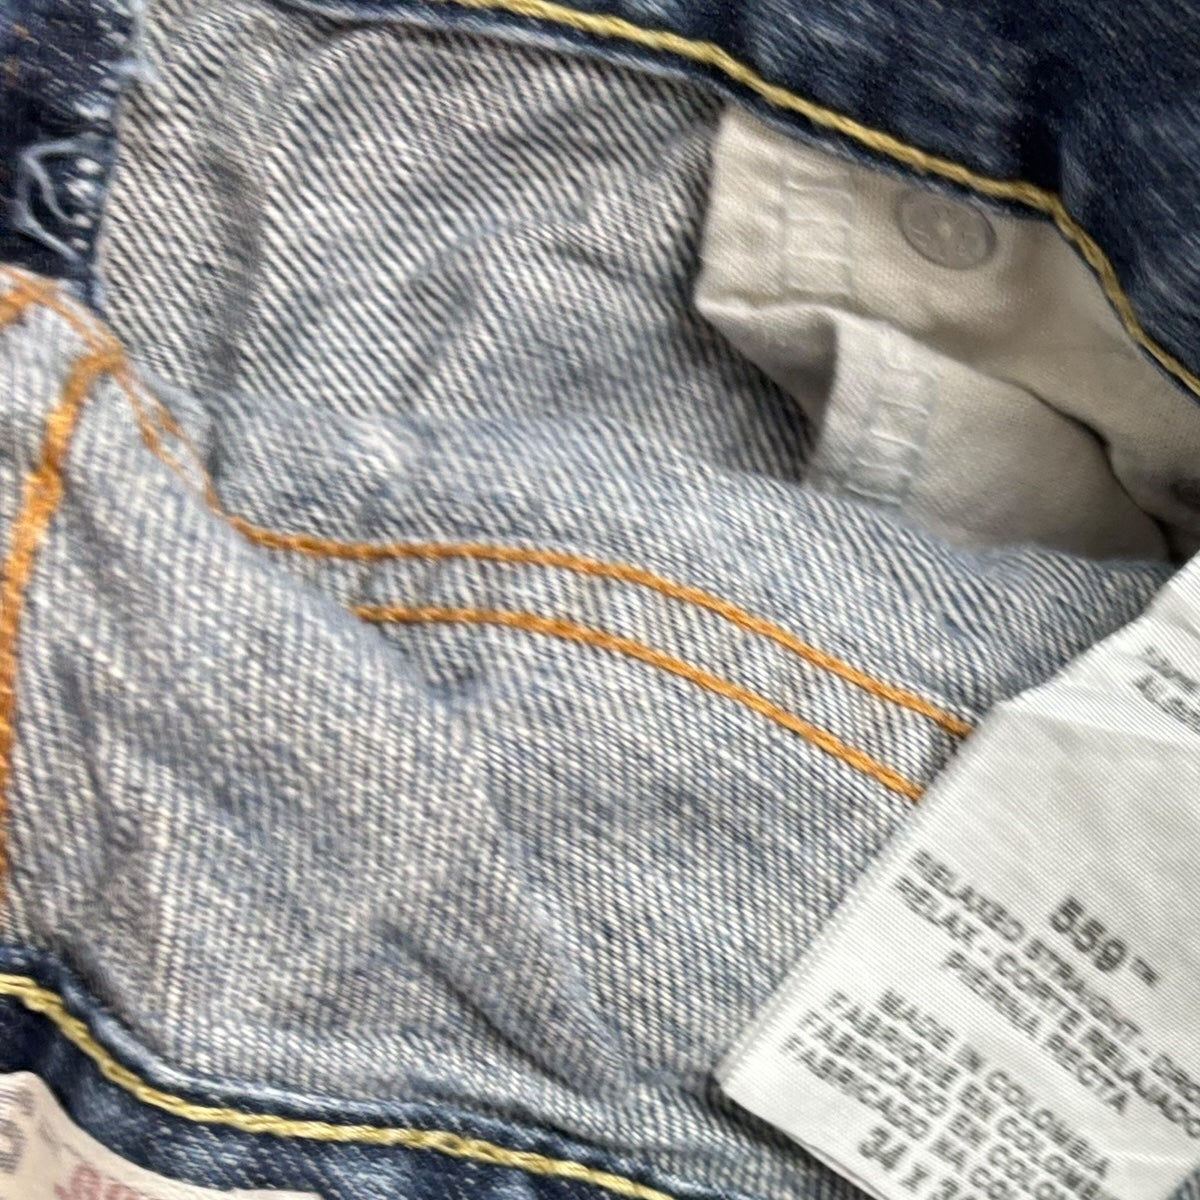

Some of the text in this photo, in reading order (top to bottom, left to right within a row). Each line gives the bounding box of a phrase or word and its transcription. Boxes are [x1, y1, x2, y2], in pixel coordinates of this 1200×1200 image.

[895, 875, 979, 948] RELAX
[997, 951, 1083, 1037] CORTE
[910, 850, 1025, 943] RELAXED
[1025, 937, 1142, 1046] STRAIGHT
[782, 1032, 931, 1142] FABRICADO
[929, 1135, 967, 1171] NA
[802, 1009, 948, 1117] FABRICADO
[948, 1111, 988, 1149] EN
[826, 990, 960, 1090] FABRIQUE
[957, 1081, 999, 1123] EN
[878, 989, 1111, 1180] MADE IN COLOMBIA
[943, 950, 1129, 1114] PIERNA RECTA
[858, 1126, 909, 1171] 34
